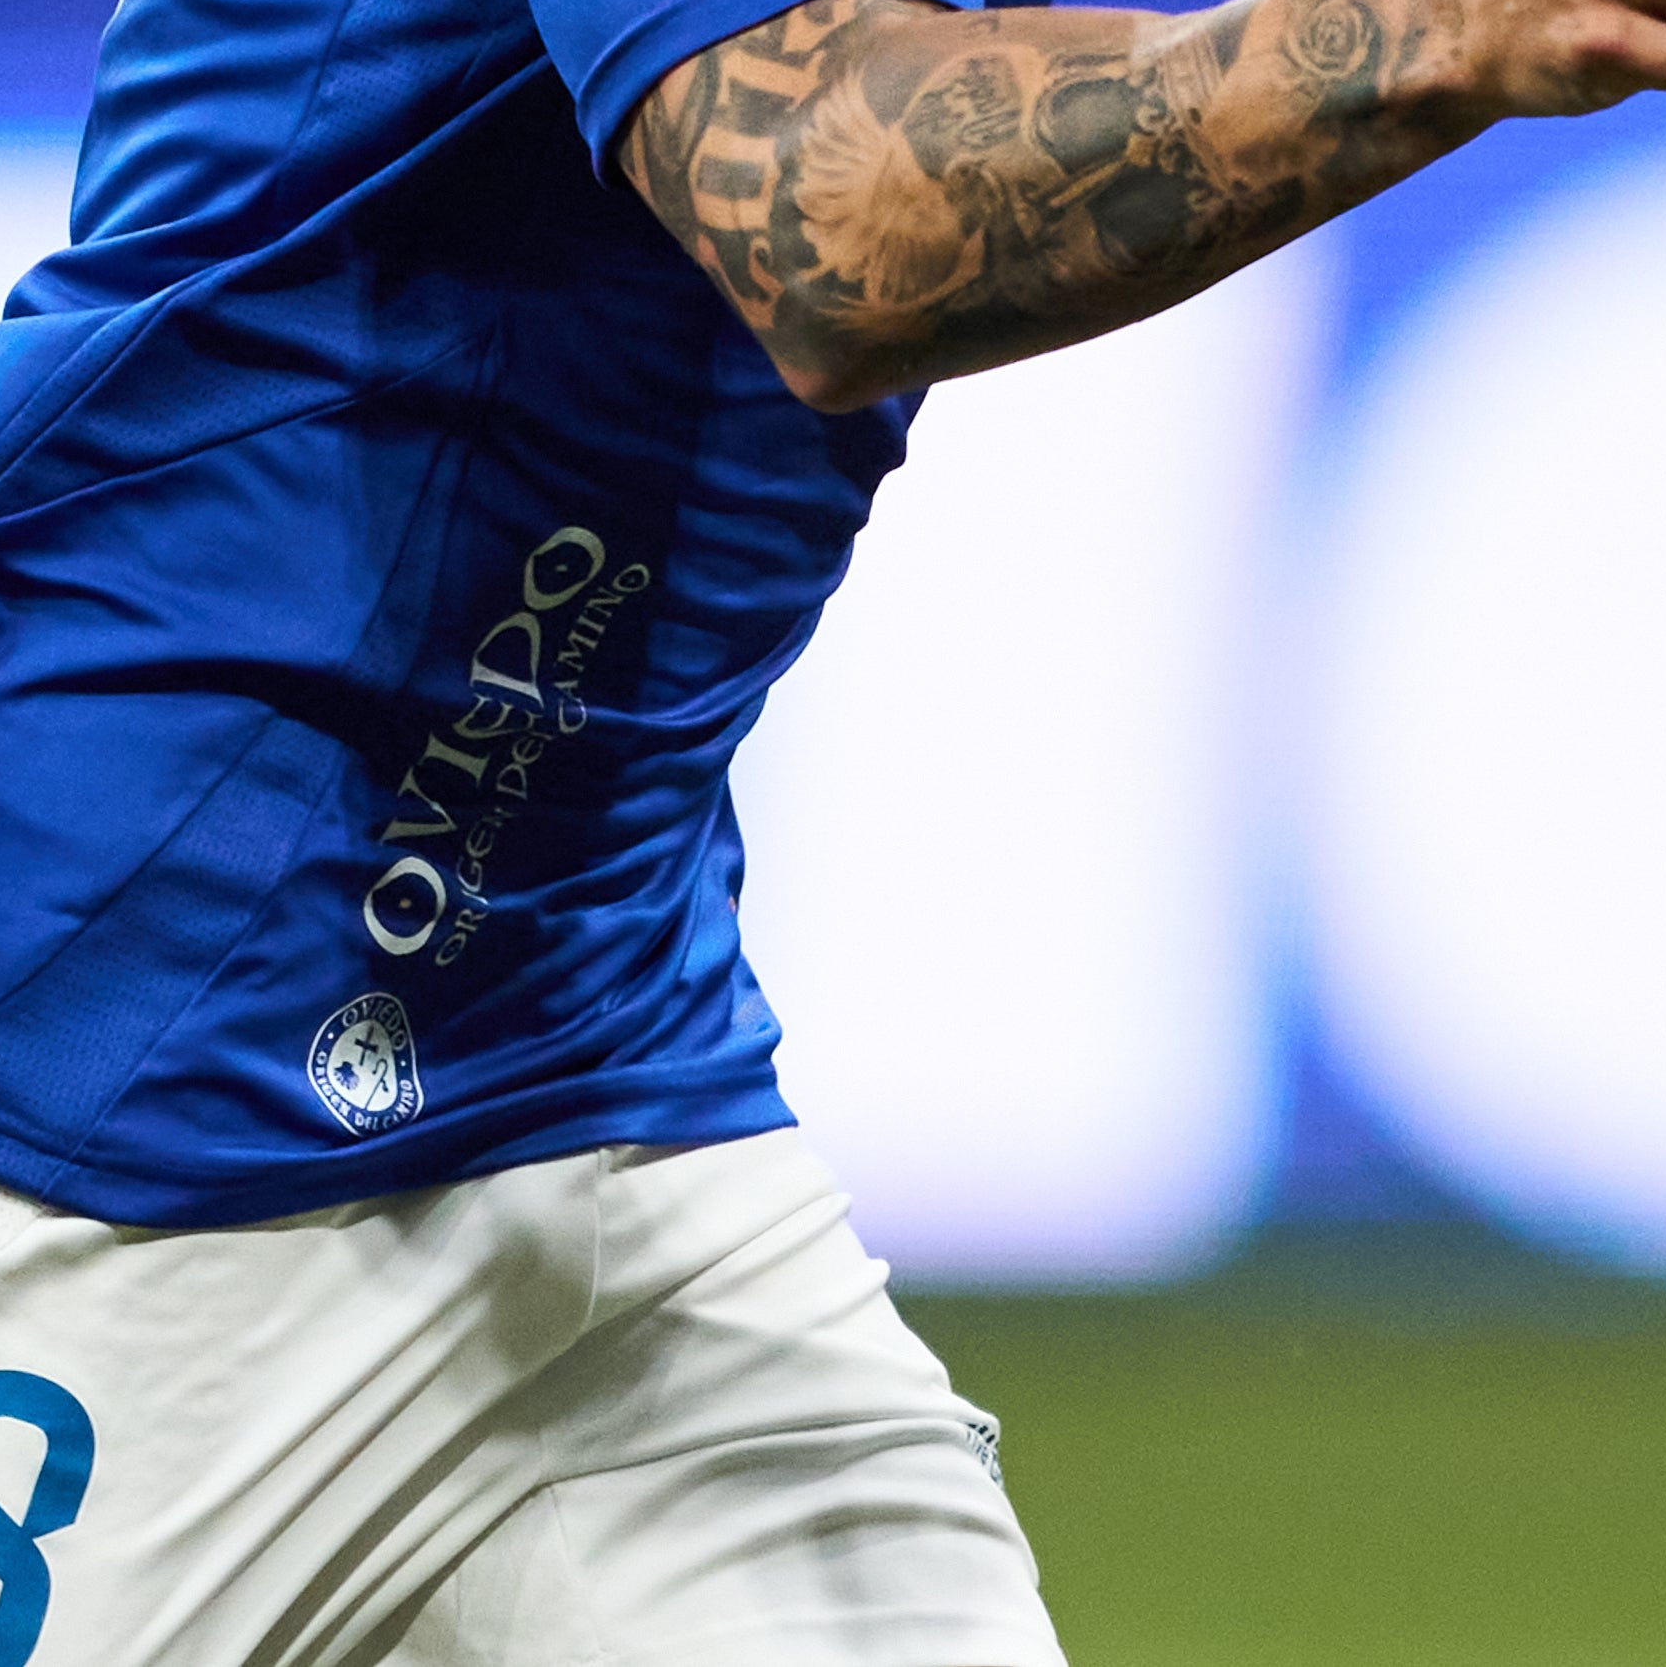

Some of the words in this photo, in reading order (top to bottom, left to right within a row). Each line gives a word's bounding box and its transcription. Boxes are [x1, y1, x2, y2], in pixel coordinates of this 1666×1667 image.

[364, 526, 605, 955] OVIEDO
[435, 807, 518, 966] ORIGEN
[557, 564, 650, 734] CAMINO
[316, 1051, 351, 1117] ORIGEN
[354, 1111, 379, 1131] DEL
[342, 1001, 407, 1051] OVIEDO
